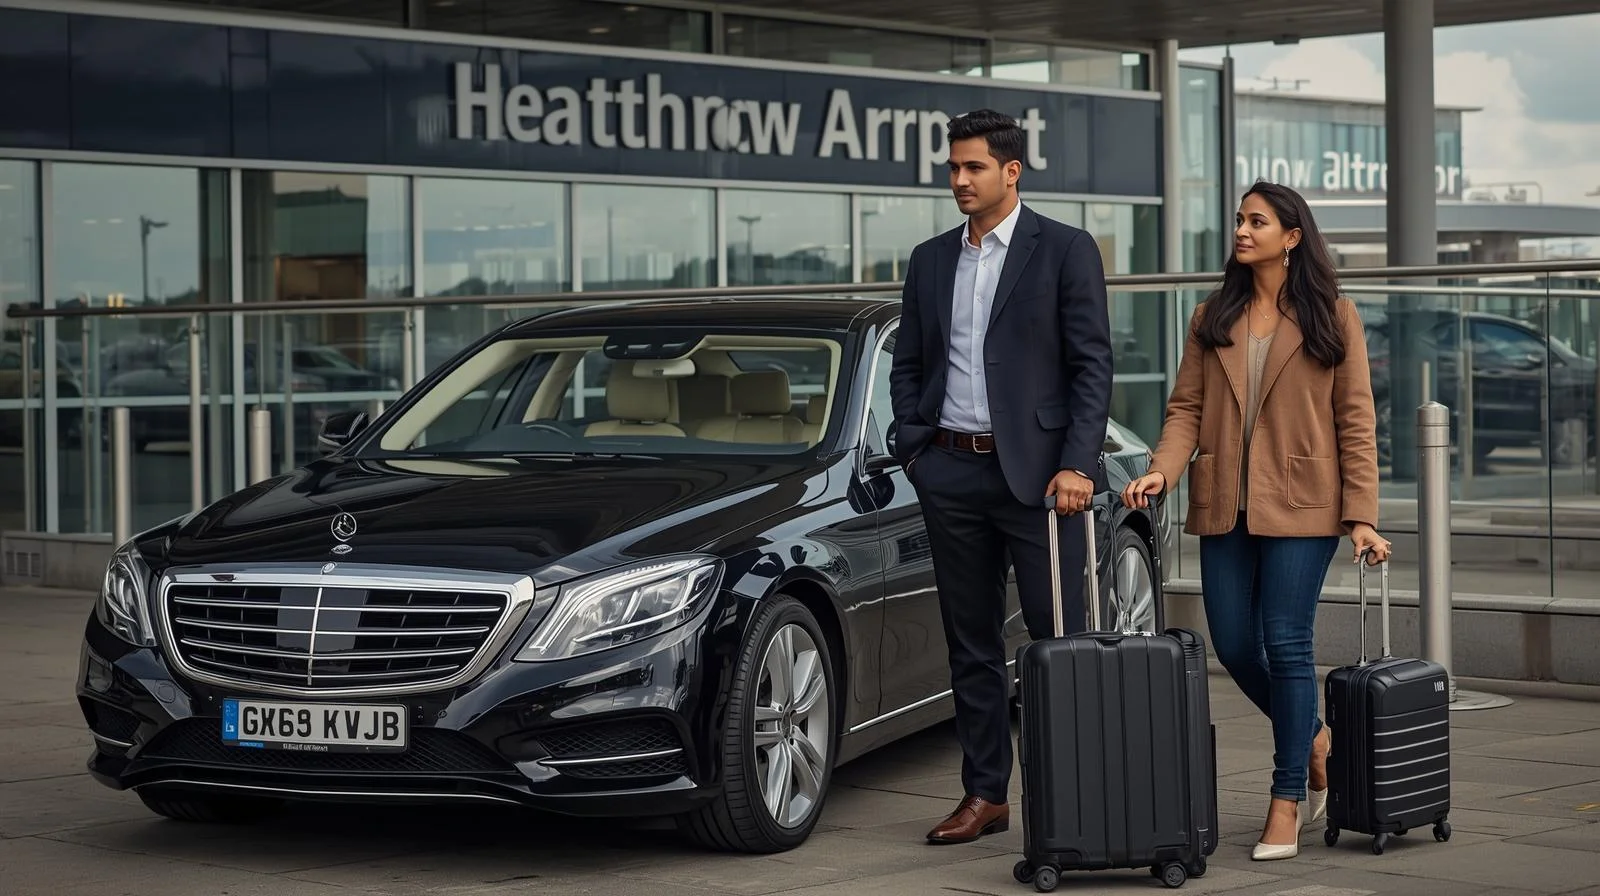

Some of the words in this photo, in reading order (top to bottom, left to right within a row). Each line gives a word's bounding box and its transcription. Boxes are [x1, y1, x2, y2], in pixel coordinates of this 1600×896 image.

[818, 88, 1048, 185] Arrpt
[242, 706, 312, 738] GX69
[323, 709, 399, 741] KVJB
